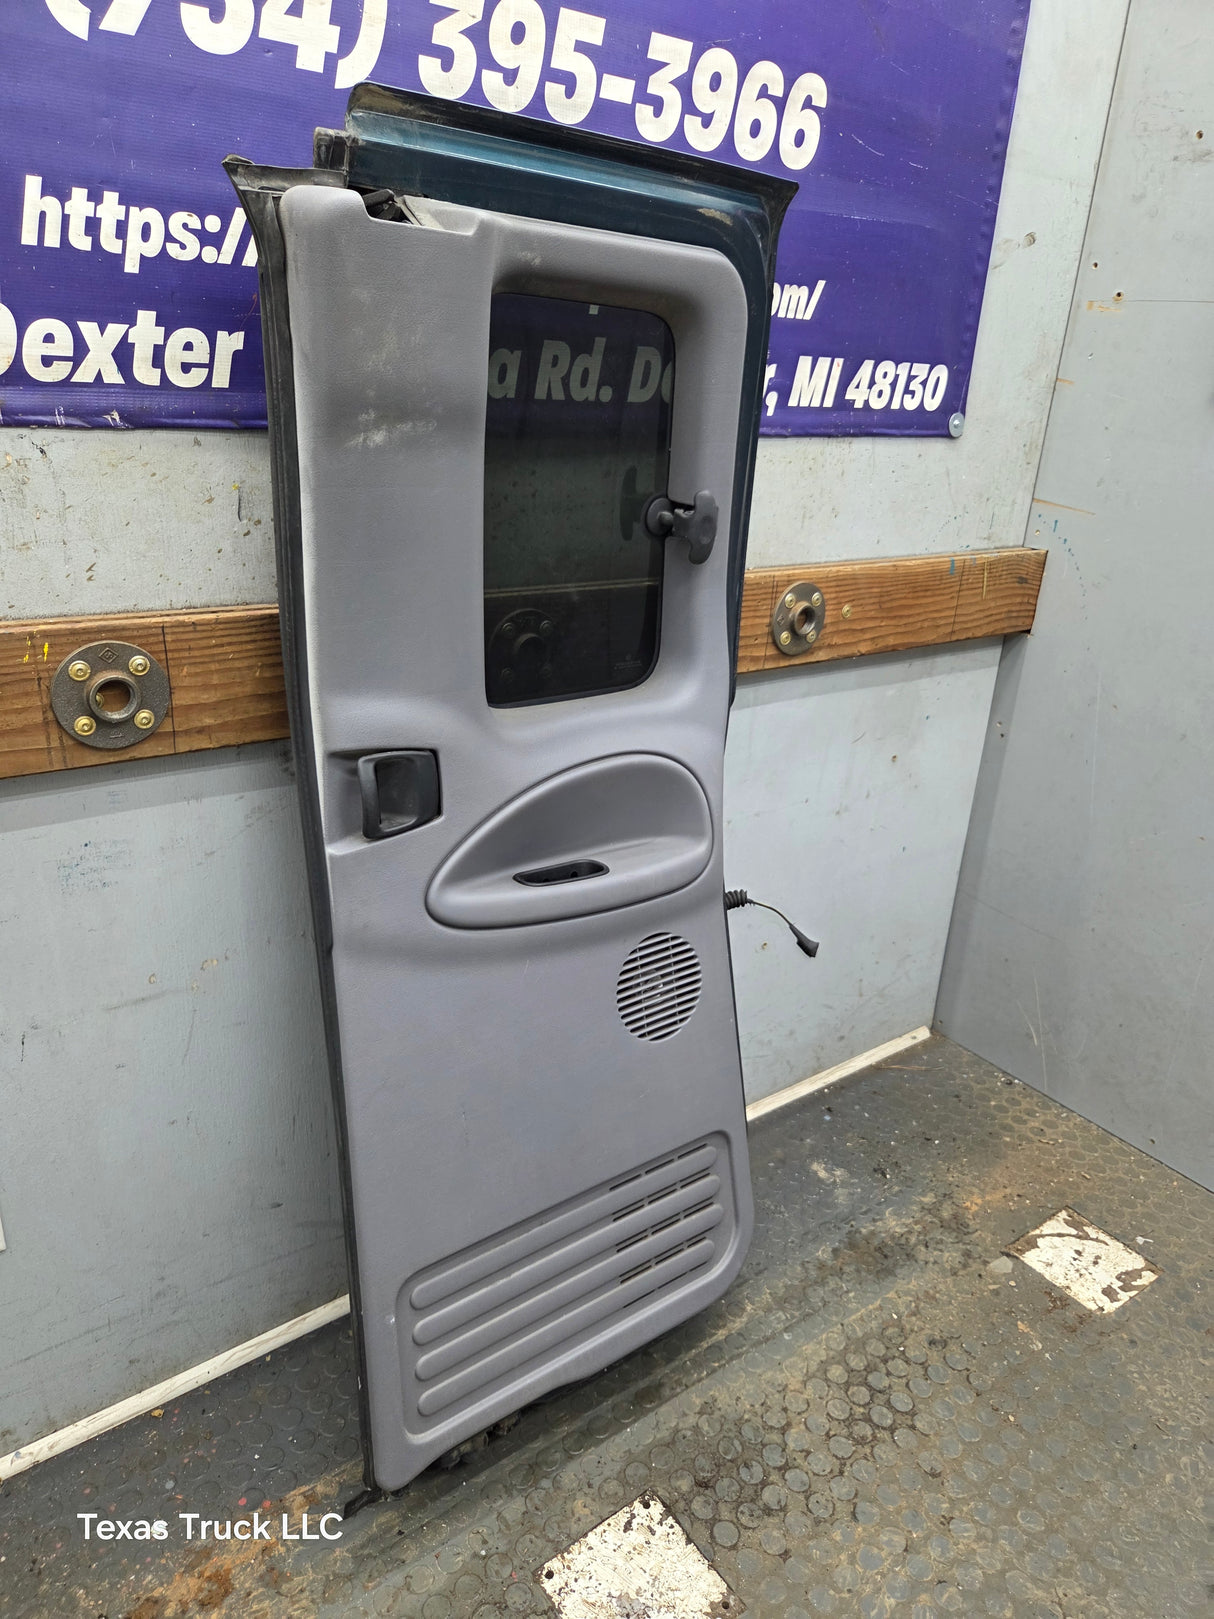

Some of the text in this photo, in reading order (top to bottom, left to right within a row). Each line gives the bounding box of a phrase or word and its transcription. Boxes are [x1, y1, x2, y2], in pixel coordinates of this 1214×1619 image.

[417, 0, 828, 171] 395-3966
[0, 302, 245, 389] exter
[534, 337, 613, 403] Rd.
[788, 355, 845, 408] MI
[844, 359, 949, 412] 48130
